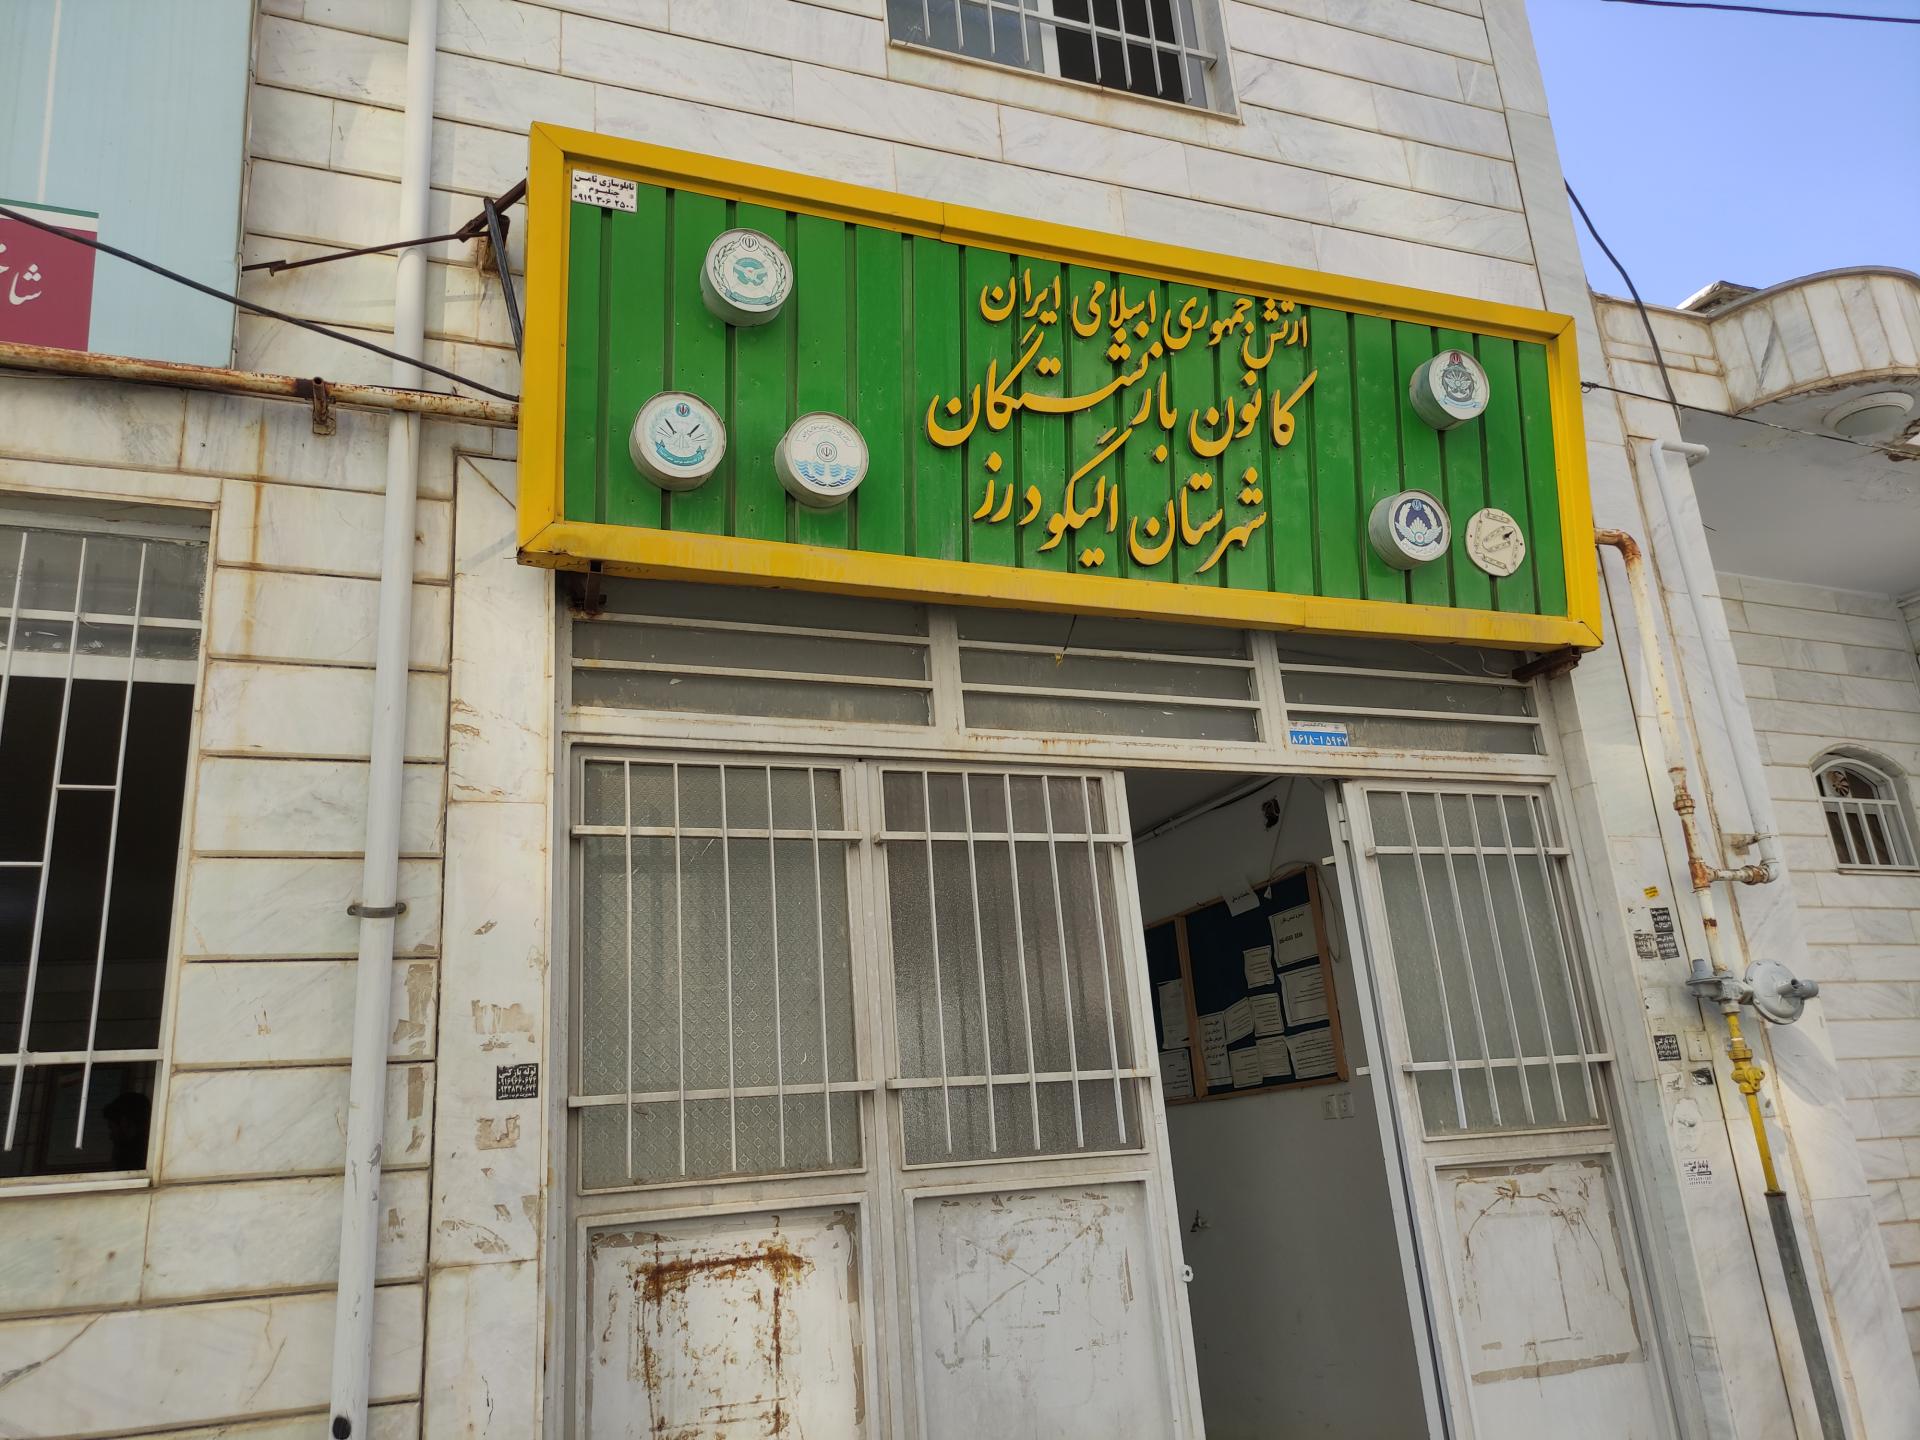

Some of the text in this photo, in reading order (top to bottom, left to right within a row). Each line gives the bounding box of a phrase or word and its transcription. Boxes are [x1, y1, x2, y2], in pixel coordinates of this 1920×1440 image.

[979, 268, 1309, 370] ارتش جمهوری اسلامی ایران
[925, 323, 1318, 465] کانون بازنشستگان
[972, 426, 1268, 574] شهرستان الیگودرز
